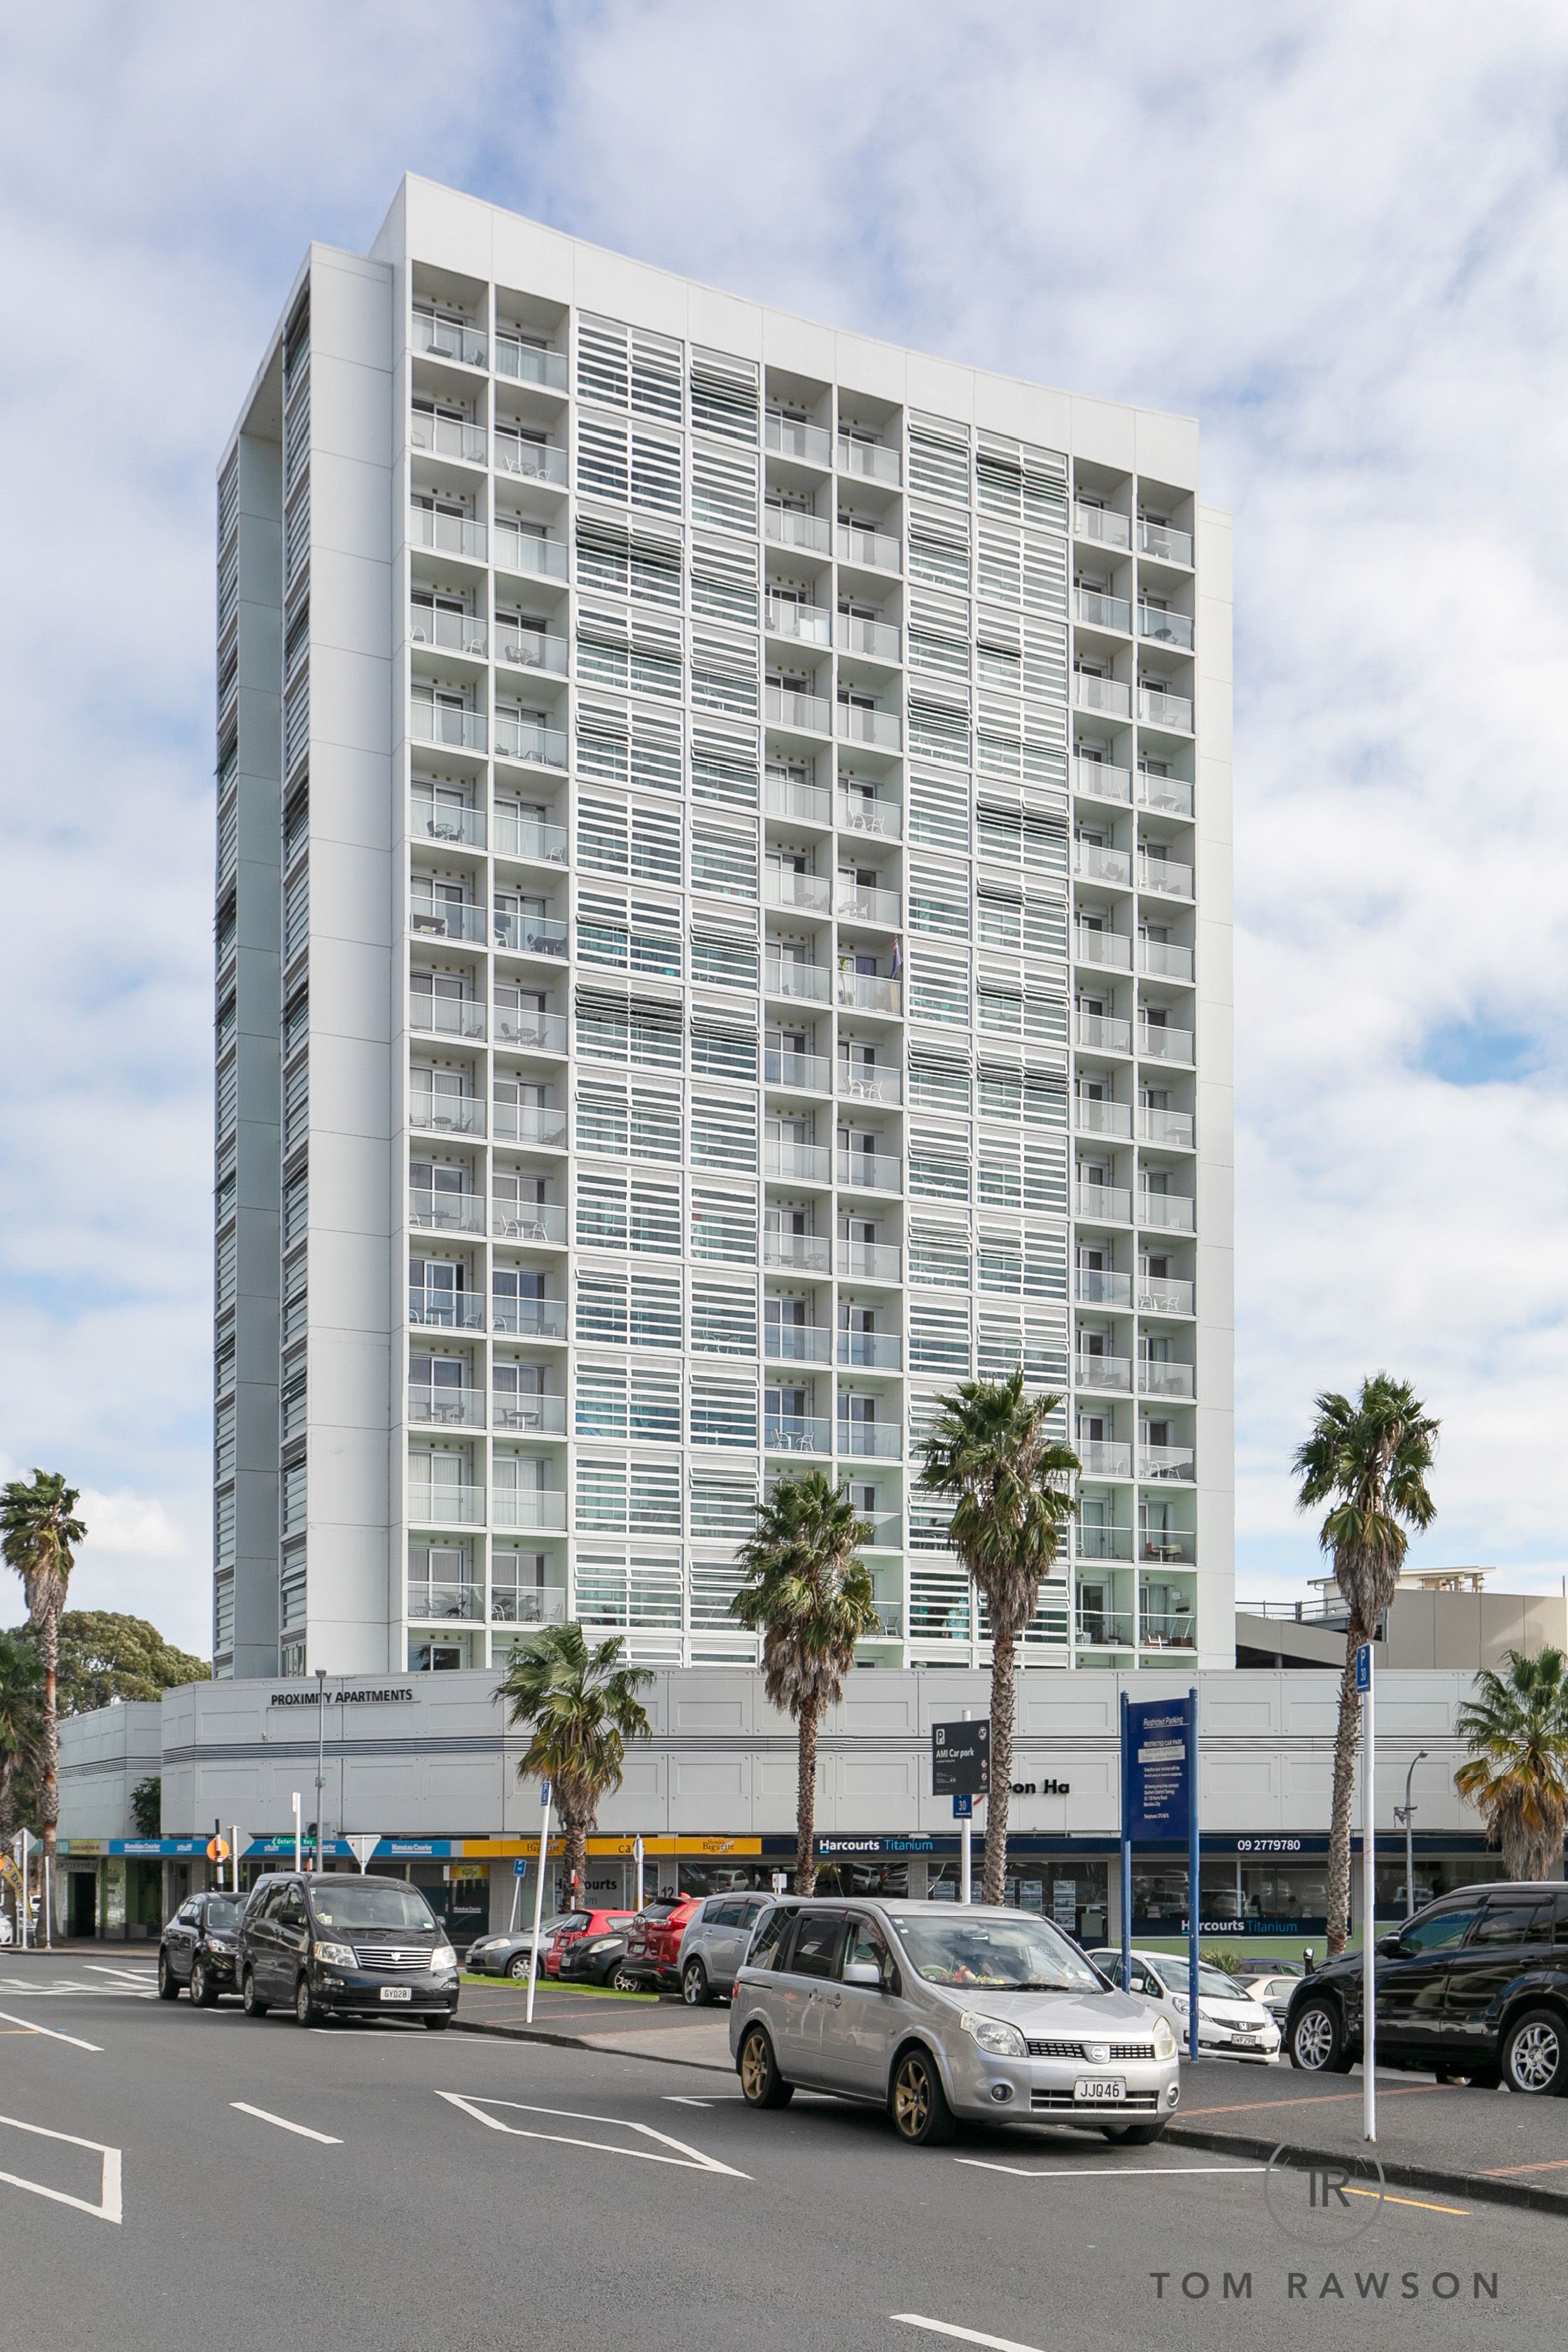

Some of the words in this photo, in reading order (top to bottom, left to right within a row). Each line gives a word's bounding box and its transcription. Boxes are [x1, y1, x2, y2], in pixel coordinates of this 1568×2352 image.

[335, 1688, 413, 1702] APARTMENTS
[936, 1749, 948, 1758] AMI
[949, 1749, 959, 1758] Car
[960, 1747, 974, 1758] park
[1044, 1779, 1070, 1793] Ha
[958, 1800, 966, 1811] 30
[527, 1843, 560, 1854] Bagette
[703, 1842, 734, 1852] Baguette
[819, 1840, 880, 1851] Harcourts
[883, 1839, 933, 1850] Titanium
[1238, 1840, 1252, 1851] 09
[1254, 1840, 1301, 1851] 2779780
[554, 1878, 617, 1889] Hourts
[662, 1886, 674, 1898] 12
[1181, 1919, 1245, 1931] Hrcourts
[1247, 1919, 1297, 1932] Titanium
[1081, 2083, 1120, 2097] JJQ46
